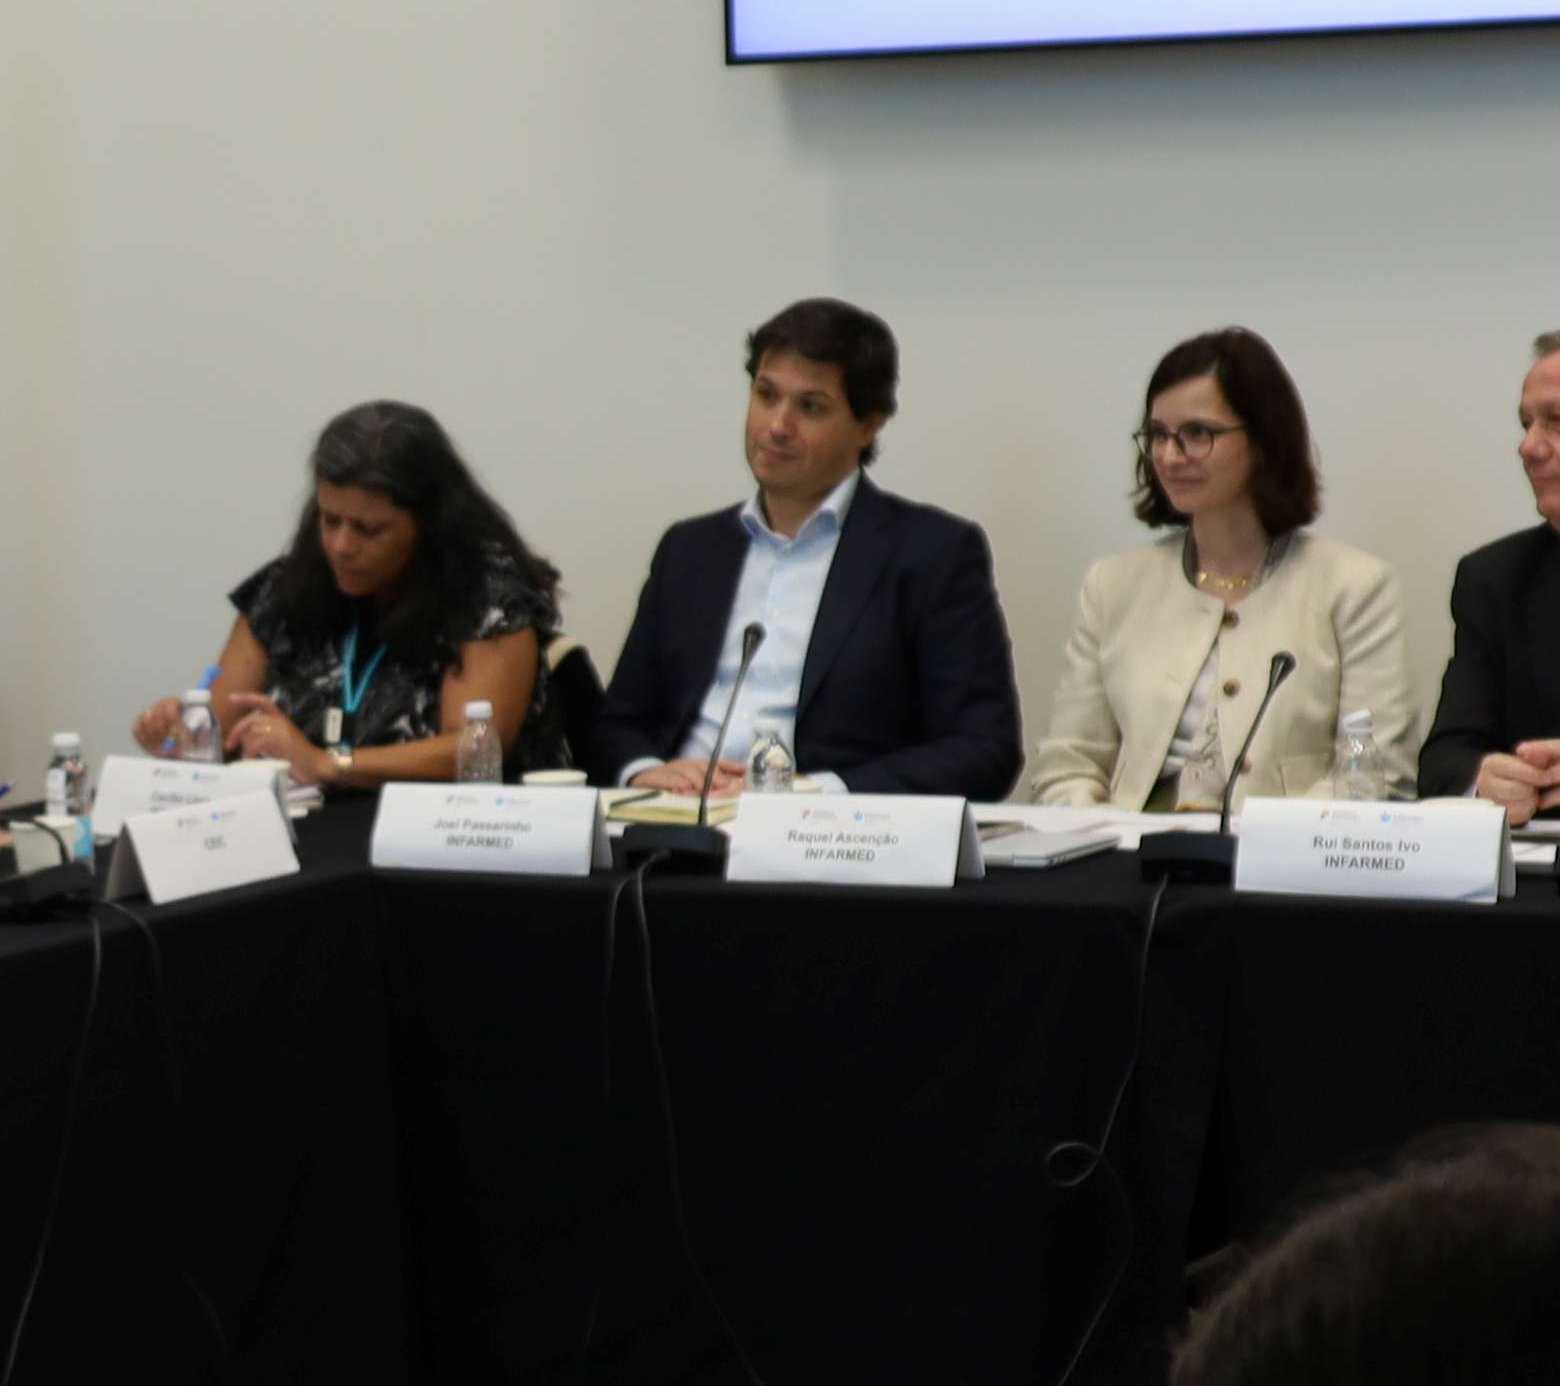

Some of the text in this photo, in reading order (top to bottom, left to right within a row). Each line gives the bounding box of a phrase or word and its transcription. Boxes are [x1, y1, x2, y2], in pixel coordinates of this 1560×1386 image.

[1313, 835, 1338, 849] Rui
[1342, 836, 1393, 852] Santos
[805, 847, 876, 862] INFARMED
[1324, 854, 1406, 871] INFARMED
